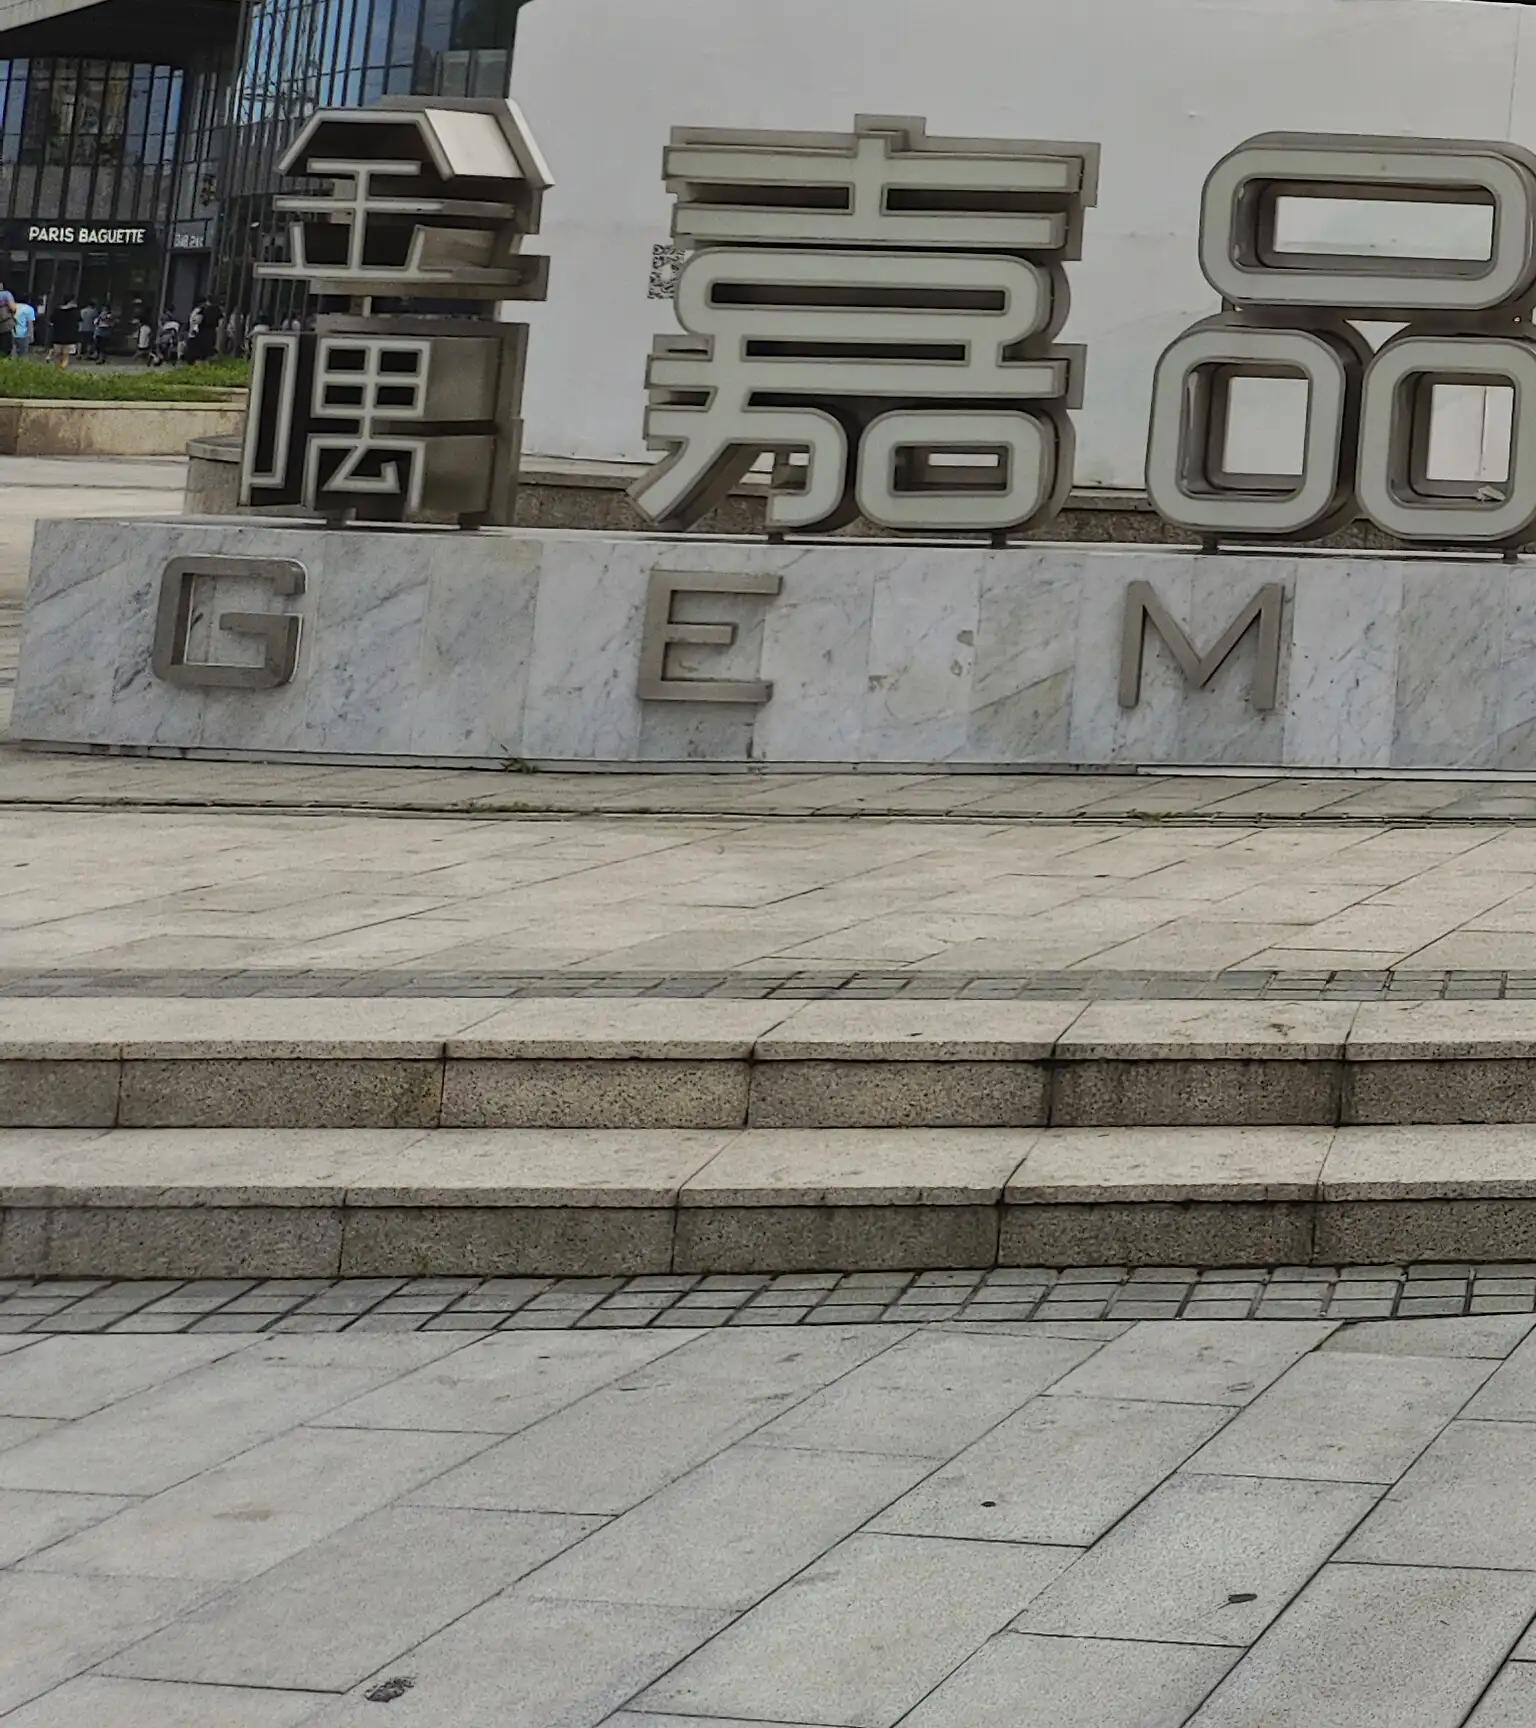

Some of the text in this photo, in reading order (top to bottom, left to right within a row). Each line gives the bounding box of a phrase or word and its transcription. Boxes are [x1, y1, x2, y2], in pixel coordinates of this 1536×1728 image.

[28, 226, 146, 244] PARIS BAGUETTE
[240, 98, 555, 522] 金隅
